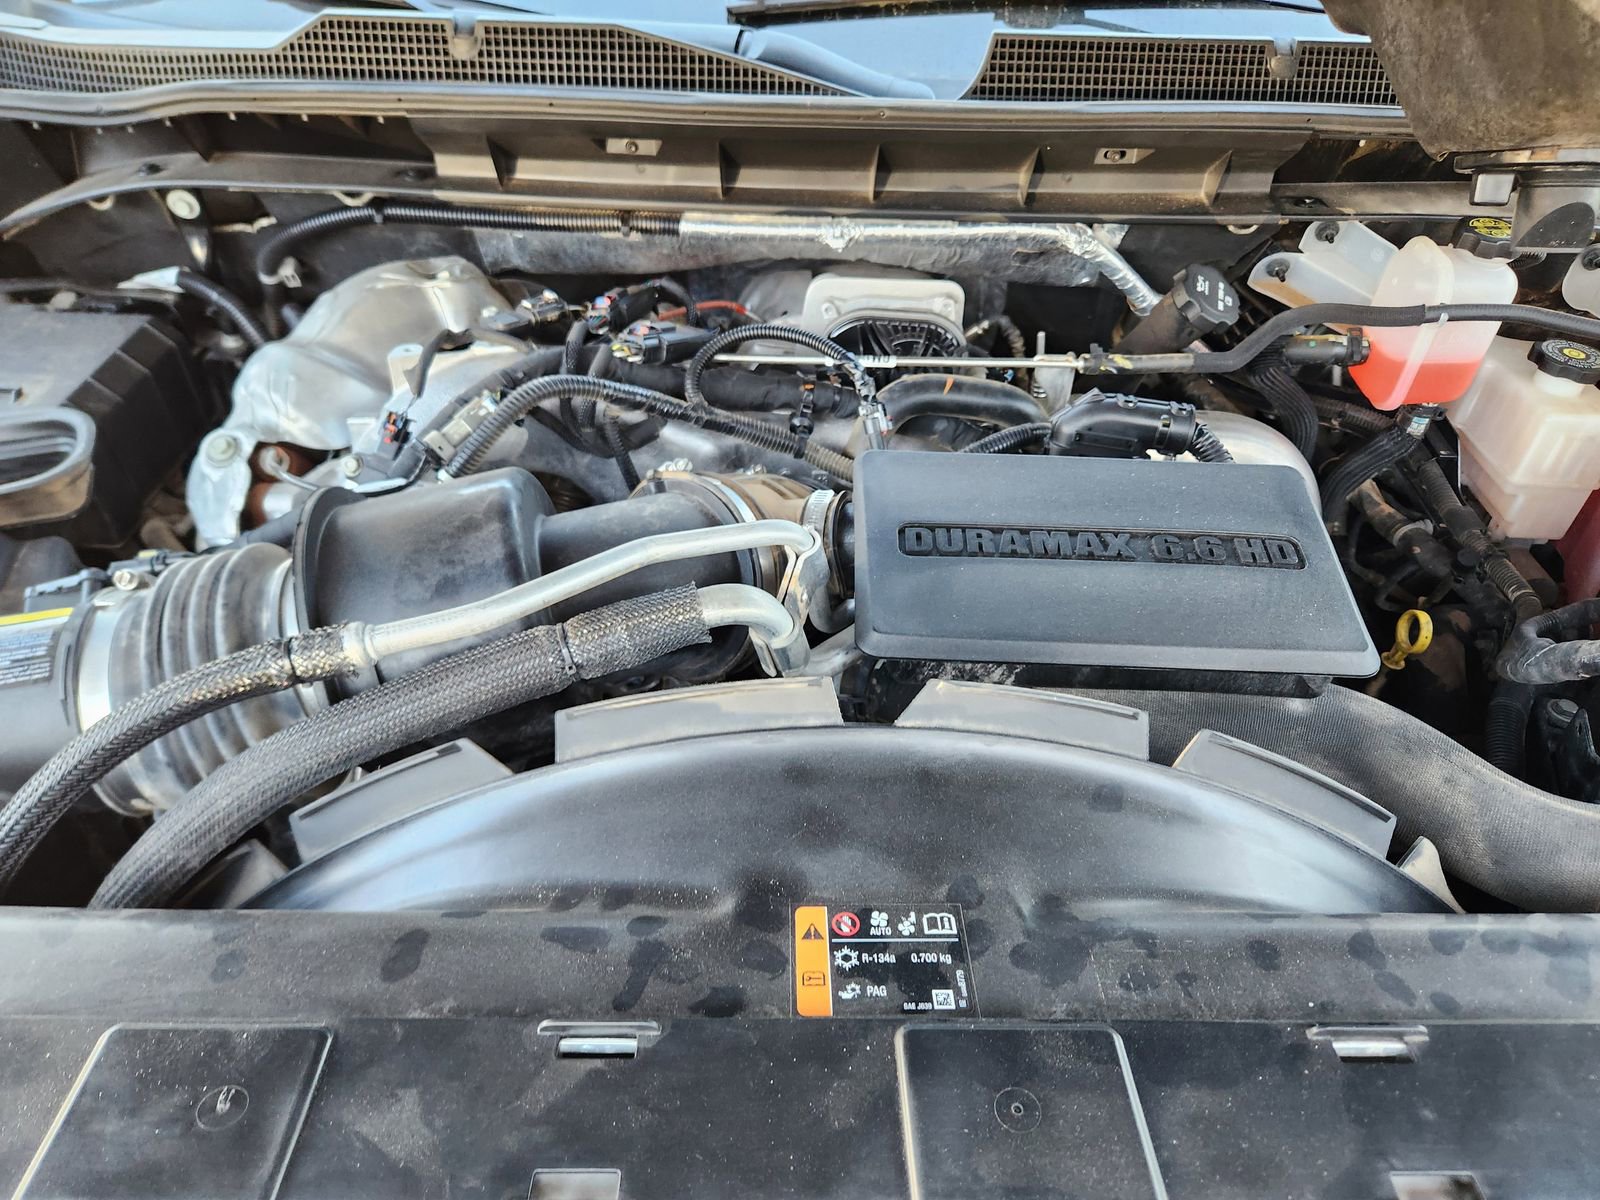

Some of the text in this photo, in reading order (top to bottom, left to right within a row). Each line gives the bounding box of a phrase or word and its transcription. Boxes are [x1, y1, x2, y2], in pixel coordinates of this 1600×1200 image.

[904, 526, 1300, 567] DURAMAX 6.6 HD
[869, 927, 892, 936] AUTO
[861, 952, 952, 965] R-134a 0.700 kg
[866, 985, 888, 997] PAG
